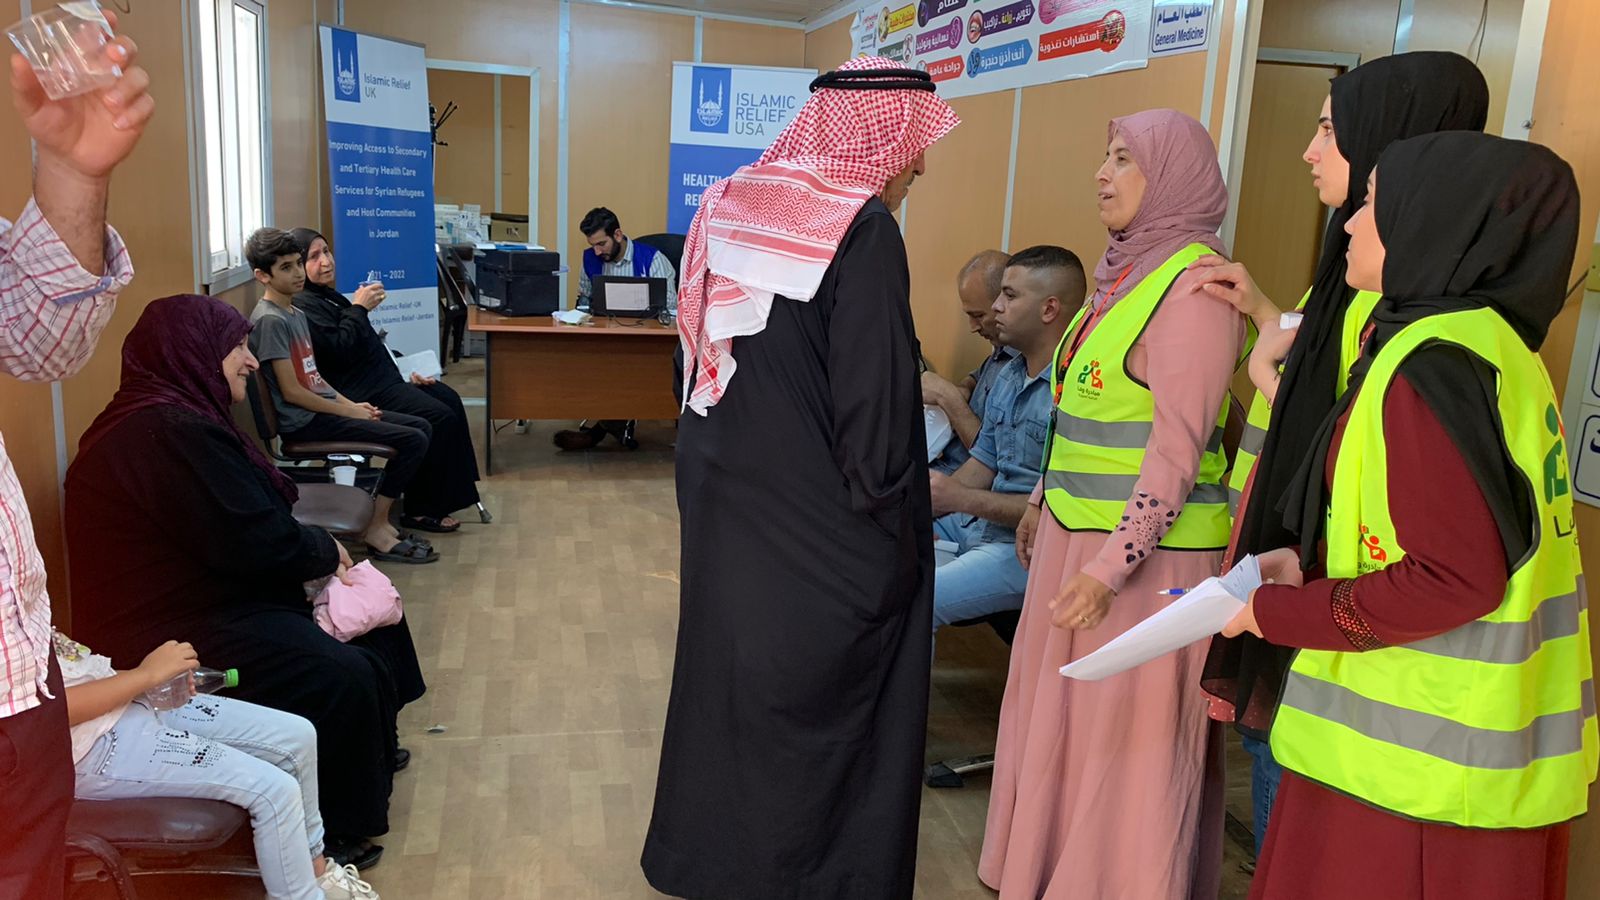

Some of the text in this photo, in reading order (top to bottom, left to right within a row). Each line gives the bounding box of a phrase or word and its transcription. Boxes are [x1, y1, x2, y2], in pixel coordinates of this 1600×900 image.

[1155, 26, 1204, 46] General Medicine
[364, 73, 390, 87] Islamic
[391, 78, 411, 90] Relief
[365, 86, 376, 99] UK
[736, 92, 796, 110] ISLAMIC
[735, 107, 787, 122] RELIEF
[735, 121, 765, 136] USA
[329, 141, 428, 158] Improving Access to Secondary
[340, 163, 417, 177] and Tertiary Health Care
[334, 184, 425, 199] Services for Syrian Refugees
[346, 207, 416, 217] and Host Communities
[369, 229, 400, 238] in Jordan
[389, 270, 405, 279] 2022
